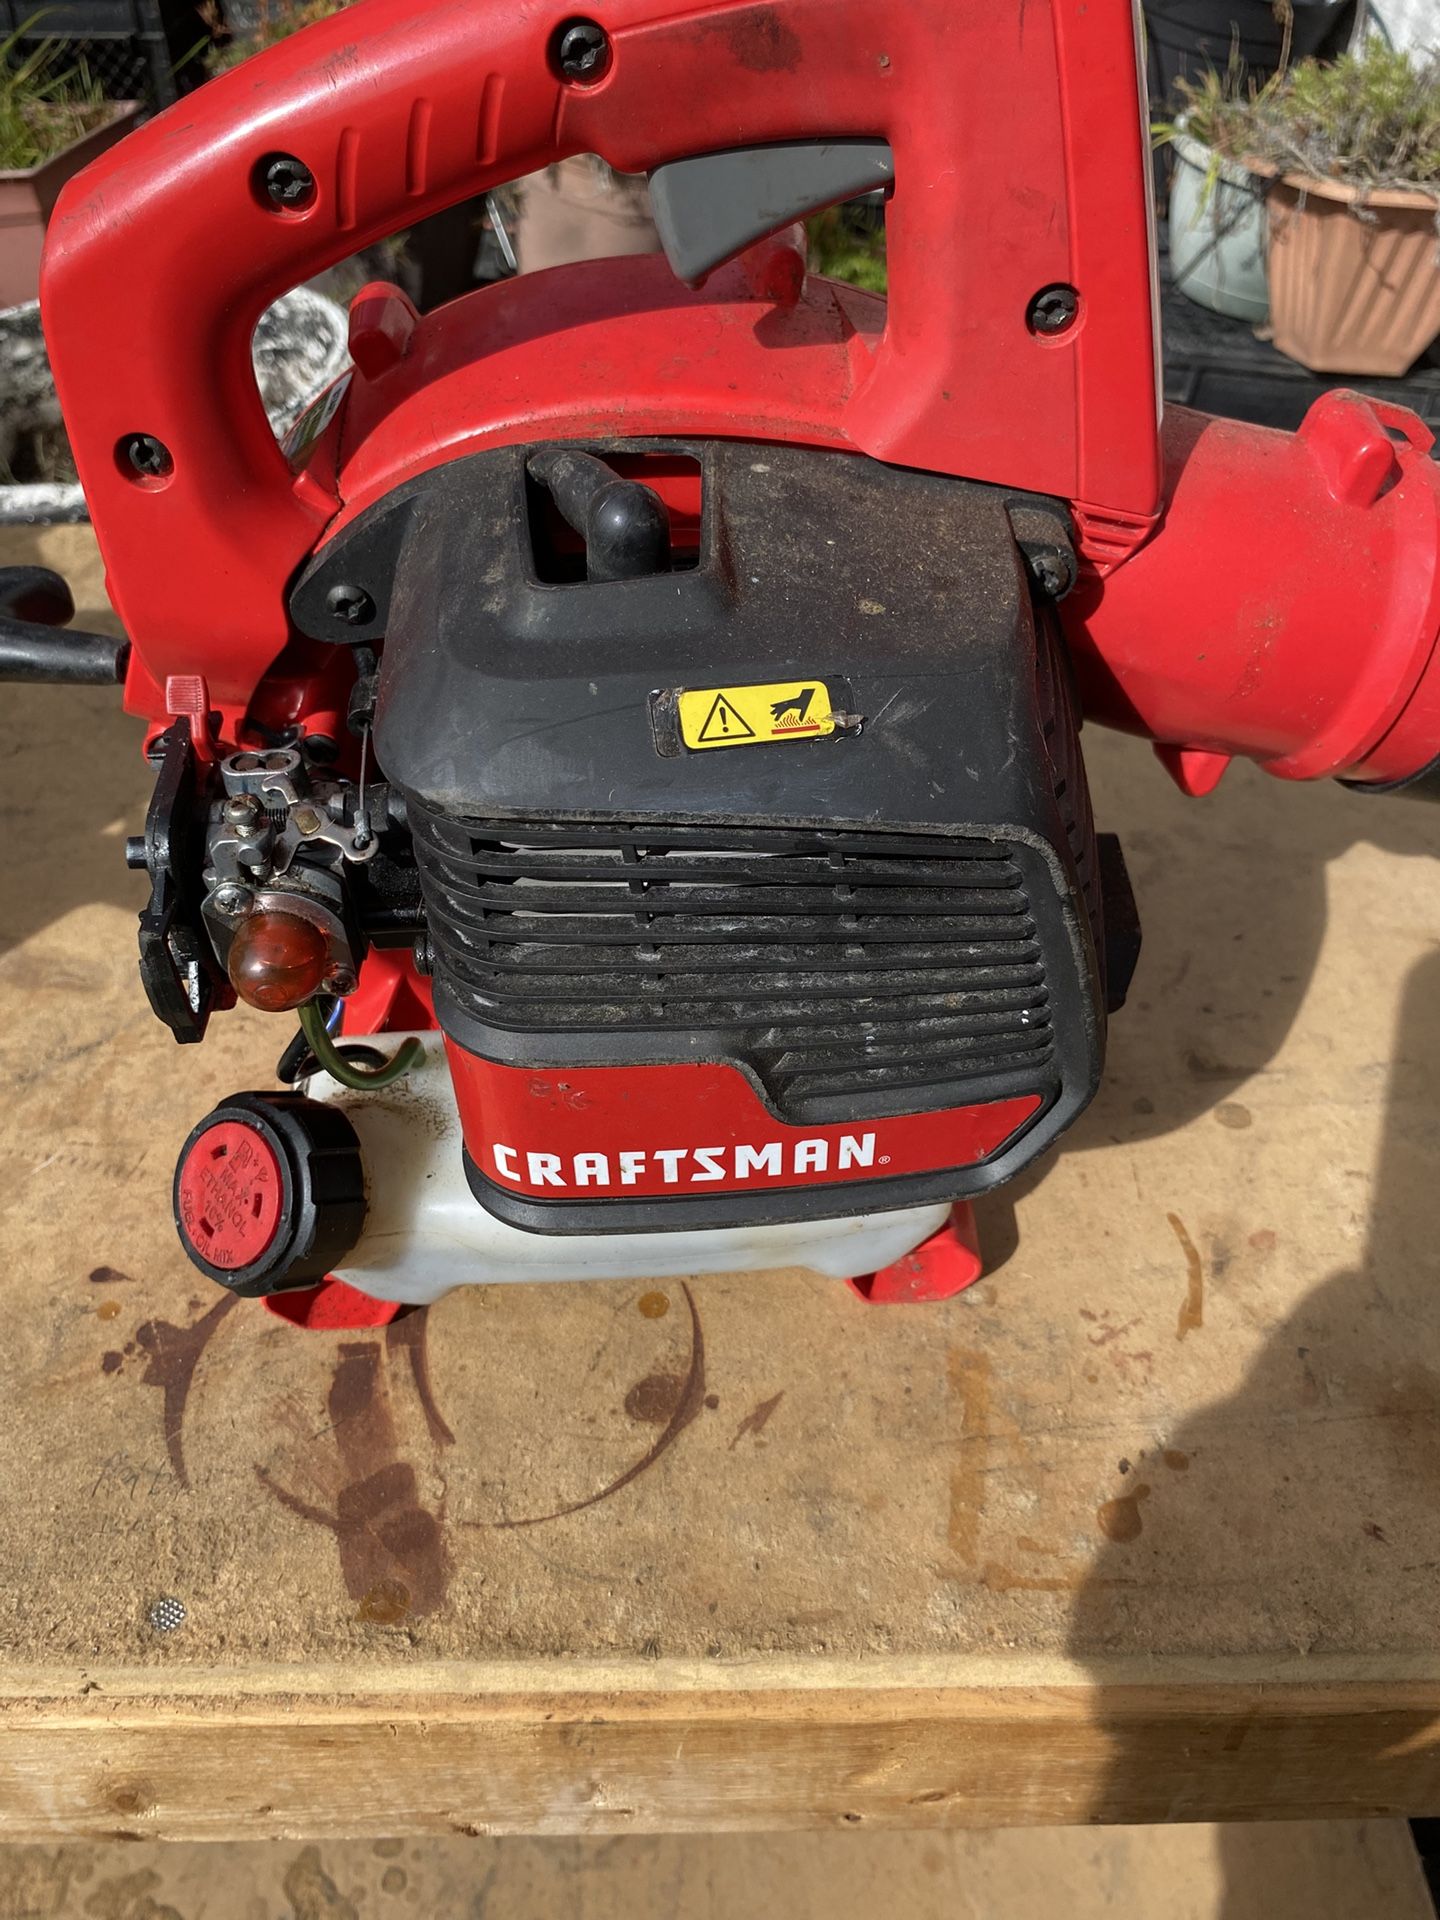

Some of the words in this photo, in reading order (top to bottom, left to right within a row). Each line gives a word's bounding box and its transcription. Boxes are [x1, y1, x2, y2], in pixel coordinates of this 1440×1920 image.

[200, 1167, 247, 1238] ETHANOL
[204, 1200, 225, 1233] 10%
[195, 1234, 211, 1257] OIL
